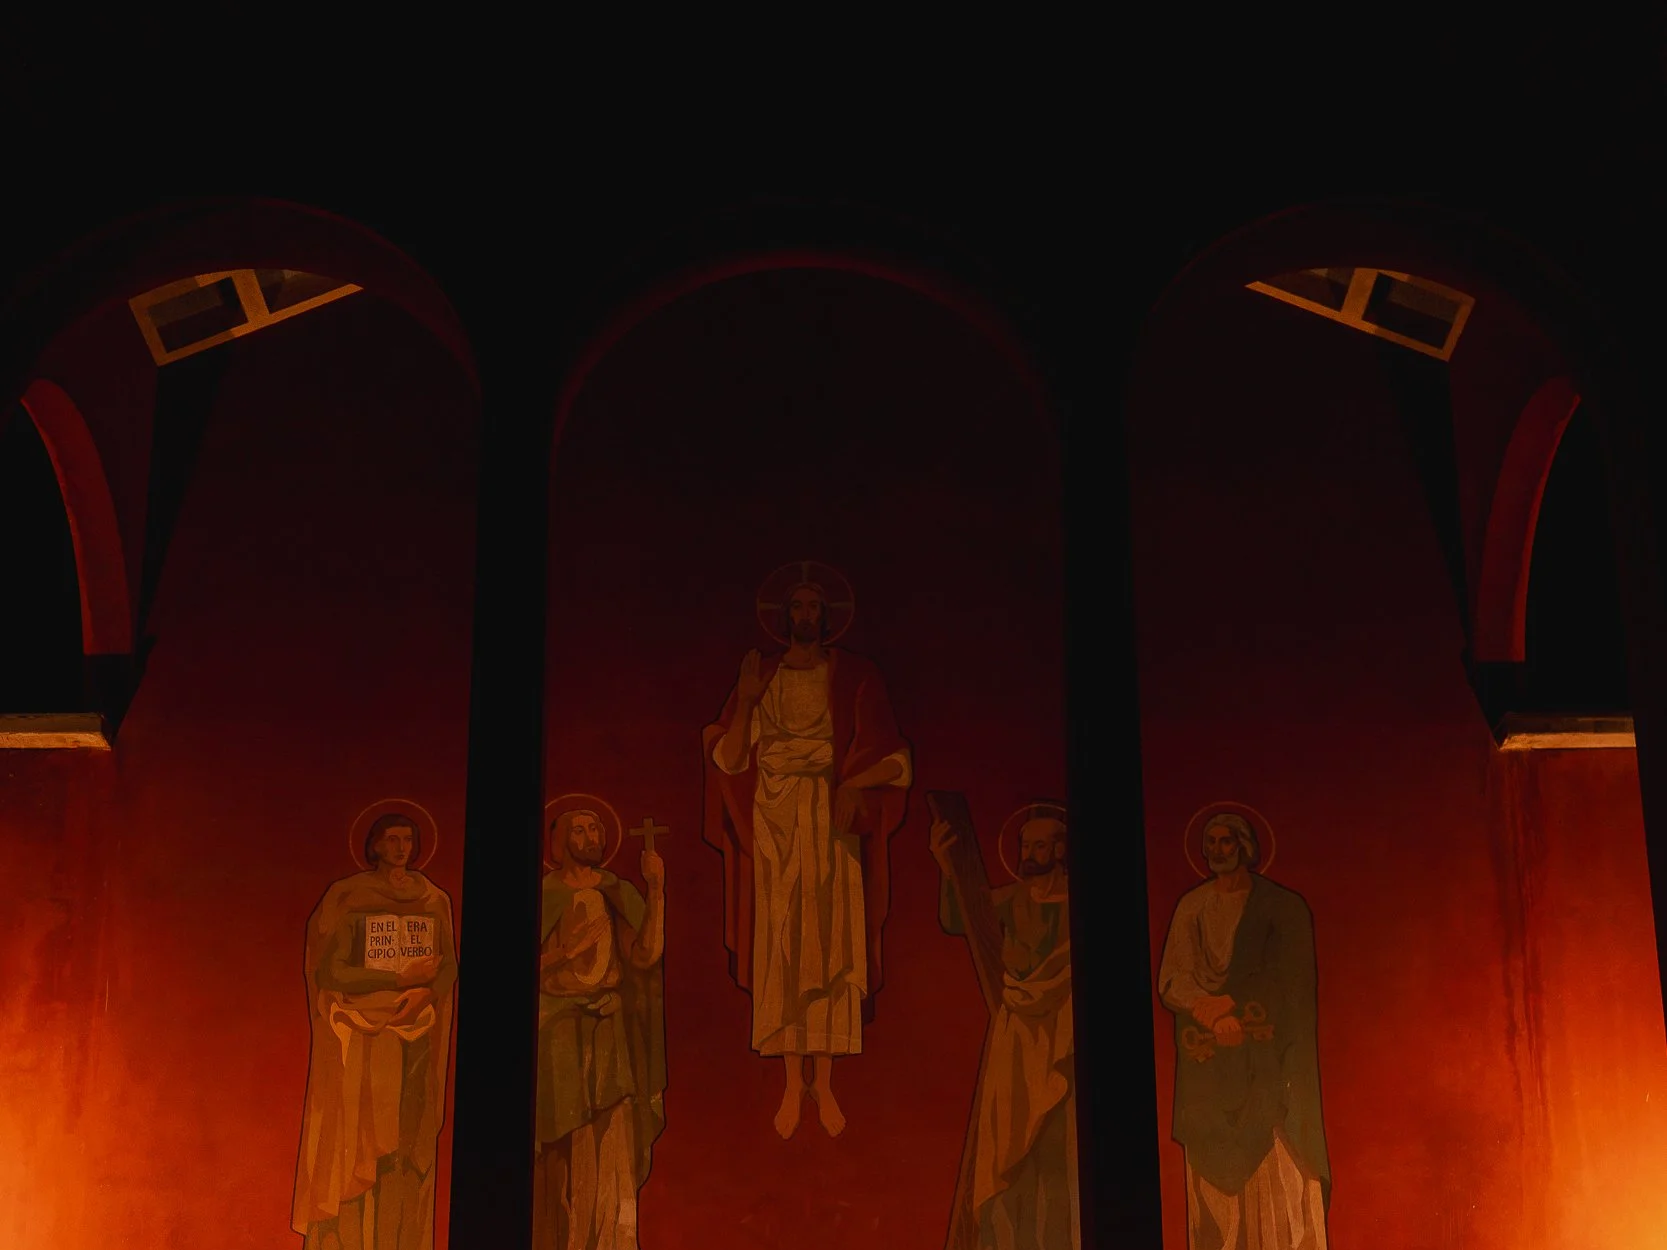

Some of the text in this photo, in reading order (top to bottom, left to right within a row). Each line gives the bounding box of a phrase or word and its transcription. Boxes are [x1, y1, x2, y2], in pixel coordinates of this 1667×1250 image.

[371, 921, 397, 933] EN EL
[408, 921, 428, 932] ERA
[410, 935, 421, 945] EL
[367, 948, 396, 959] CIPIO
[400, 946, 432, 957] VERBO
